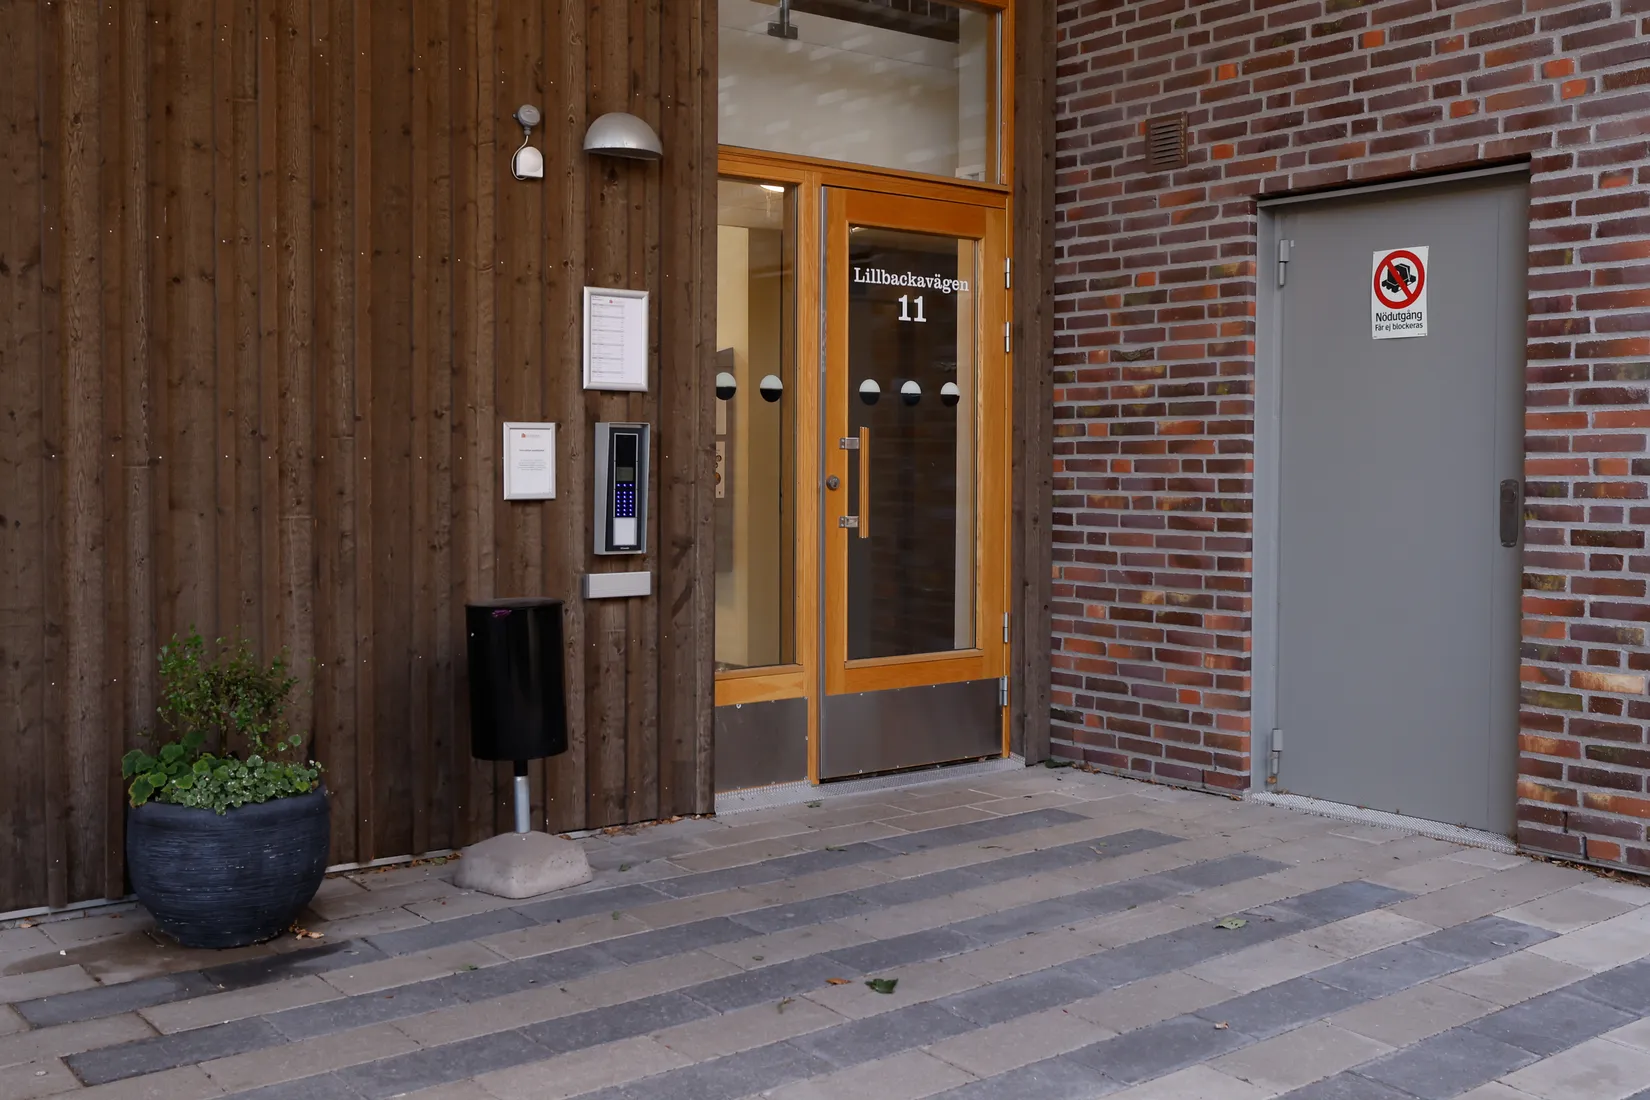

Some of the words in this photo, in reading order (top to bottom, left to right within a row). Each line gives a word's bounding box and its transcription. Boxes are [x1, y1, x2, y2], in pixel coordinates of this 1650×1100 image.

[854, 267, 969, 293] Lillbackavägen
[898, 294, 927, 322] 11
[1375, 309, 1423, 323] Nödutgång
[1385, 323, 1391, 331] ej
[1392, 322, 1424, 330] blockeras
